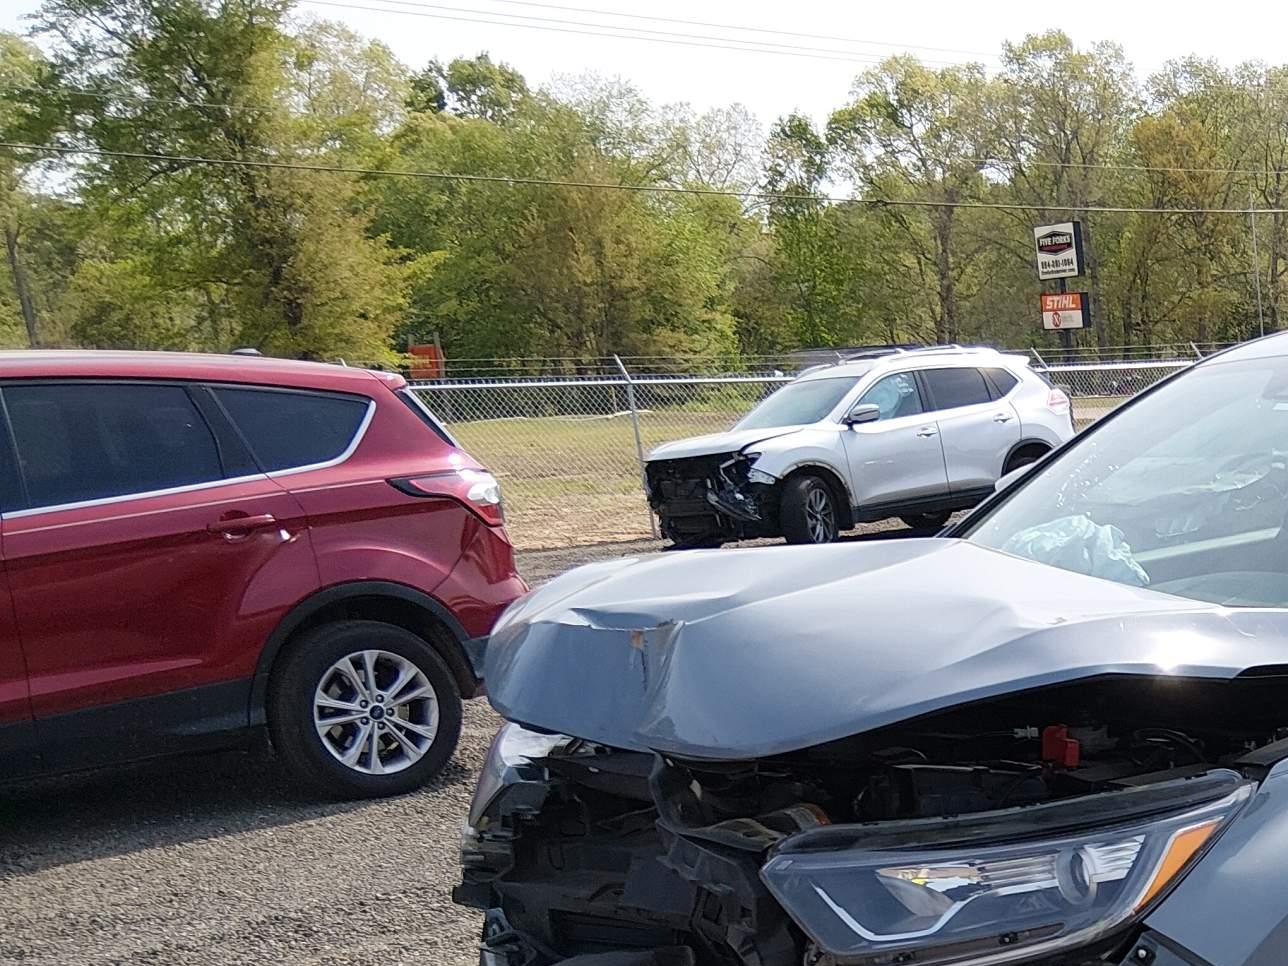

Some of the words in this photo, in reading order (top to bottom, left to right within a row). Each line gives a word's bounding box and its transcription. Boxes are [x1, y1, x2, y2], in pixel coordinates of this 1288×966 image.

[1040, 238, 1052, 247] FIVE
[1052, 235, 1070, 245] FORKS
[1046, 295, 1077, 310] STIHL
